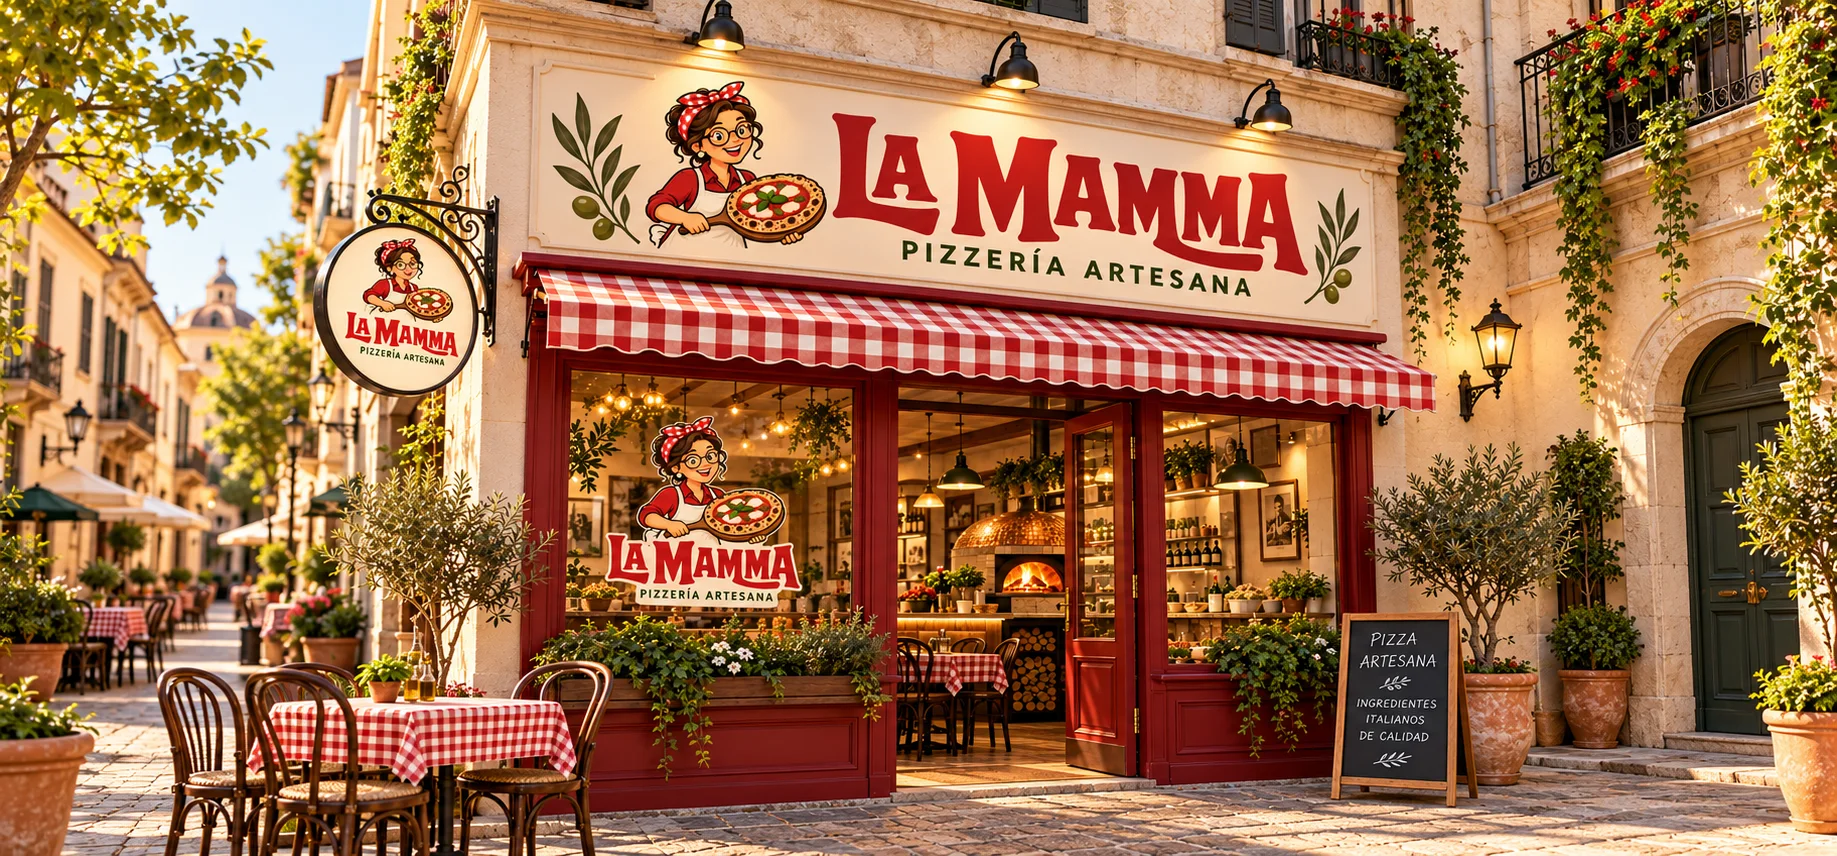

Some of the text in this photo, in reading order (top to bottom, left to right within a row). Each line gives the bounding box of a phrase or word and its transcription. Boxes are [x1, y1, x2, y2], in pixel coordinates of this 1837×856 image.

[832, 112, 1309, 276] LA MAMMA
[902, 240, 1251, 297] PIZZERÍA ARTESANA
[345, 311, 459, 358] LA MAMMA
[359, 346, 401, 360] PIZZERÍA
[607, 534, 801, 590] LA MAMMA
[640, 587, 774, 602] PIZZERÍA ARTESANA
[1370, 631, 1417, 647] PIZZA
[1359, 654, 1436, 669] ARTESANA
[1356, 698, 1437, 709] INGREDIENTES
[1365, 714, 1425, 725] ITALIANOS
[1359, 730, 1430, 742] DE CALIDAD
